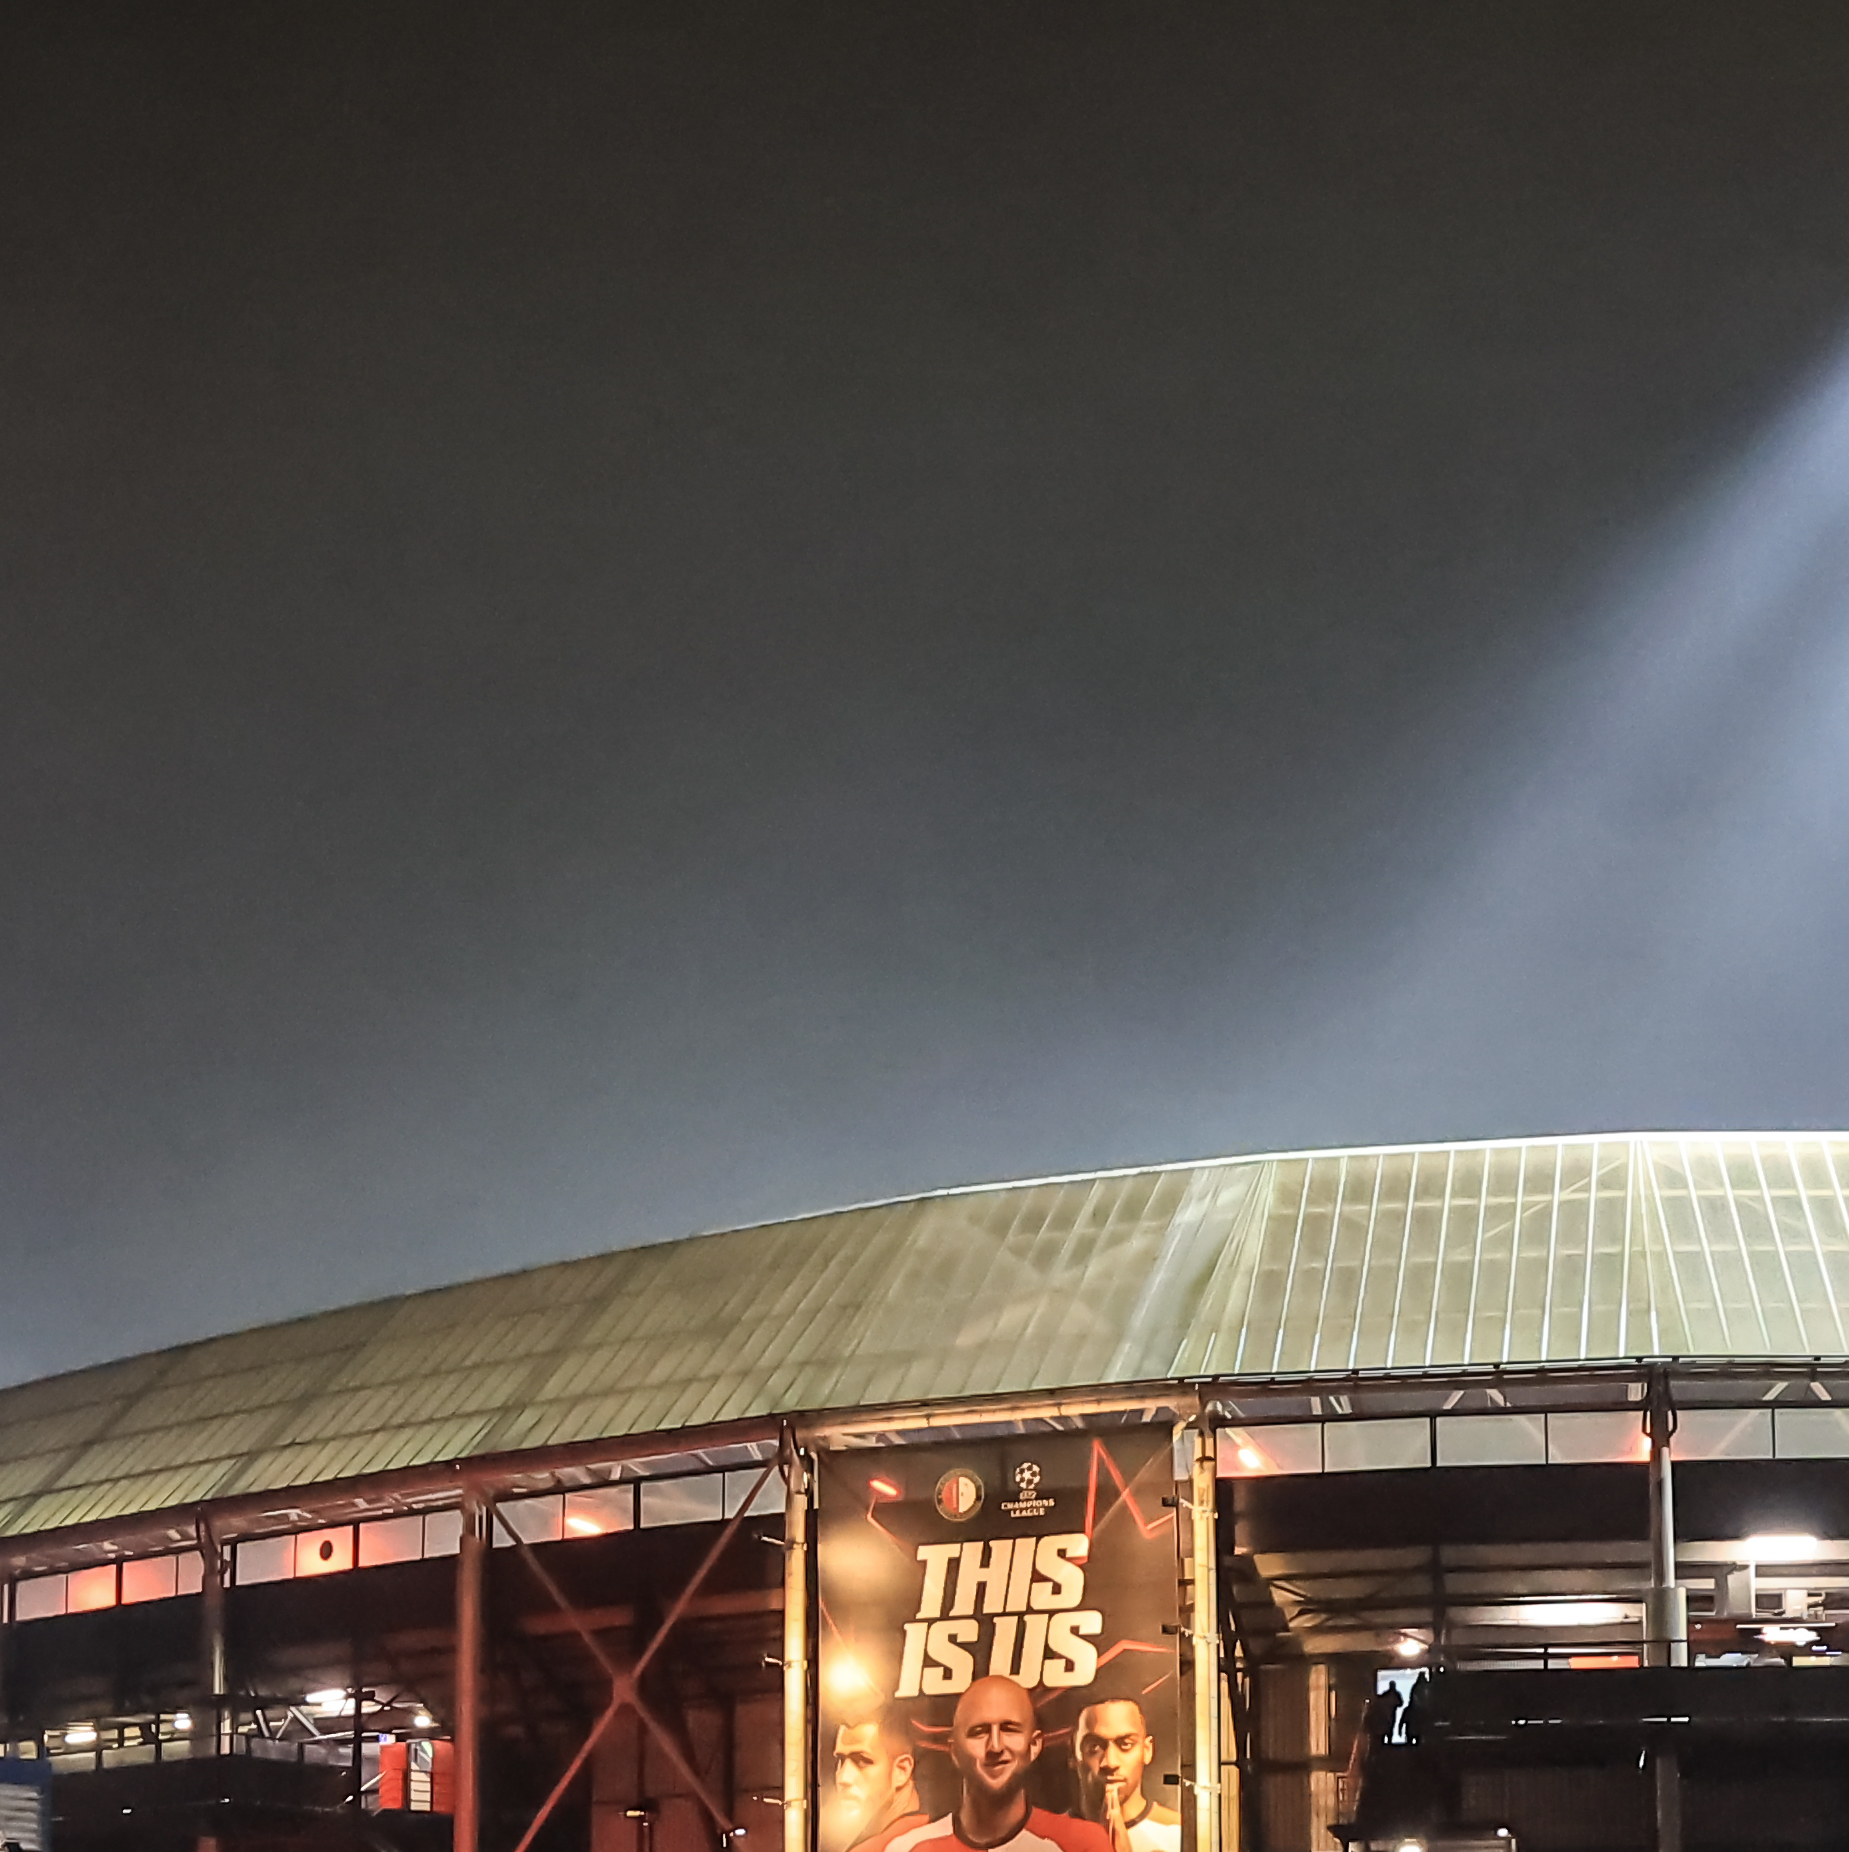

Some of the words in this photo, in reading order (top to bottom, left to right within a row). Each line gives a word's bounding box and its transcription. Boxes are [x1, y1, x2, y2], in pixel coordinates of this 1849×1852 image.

[1001, 1498, 1055, 1510] CHAMPIONS
[1011, 1508, 1045, 1517] LEAGUE
[915, 1533, 1089, 1619] THIS
[895, 1617, 979, 1697] IS
[989, 1610, 1103, 1688] US
